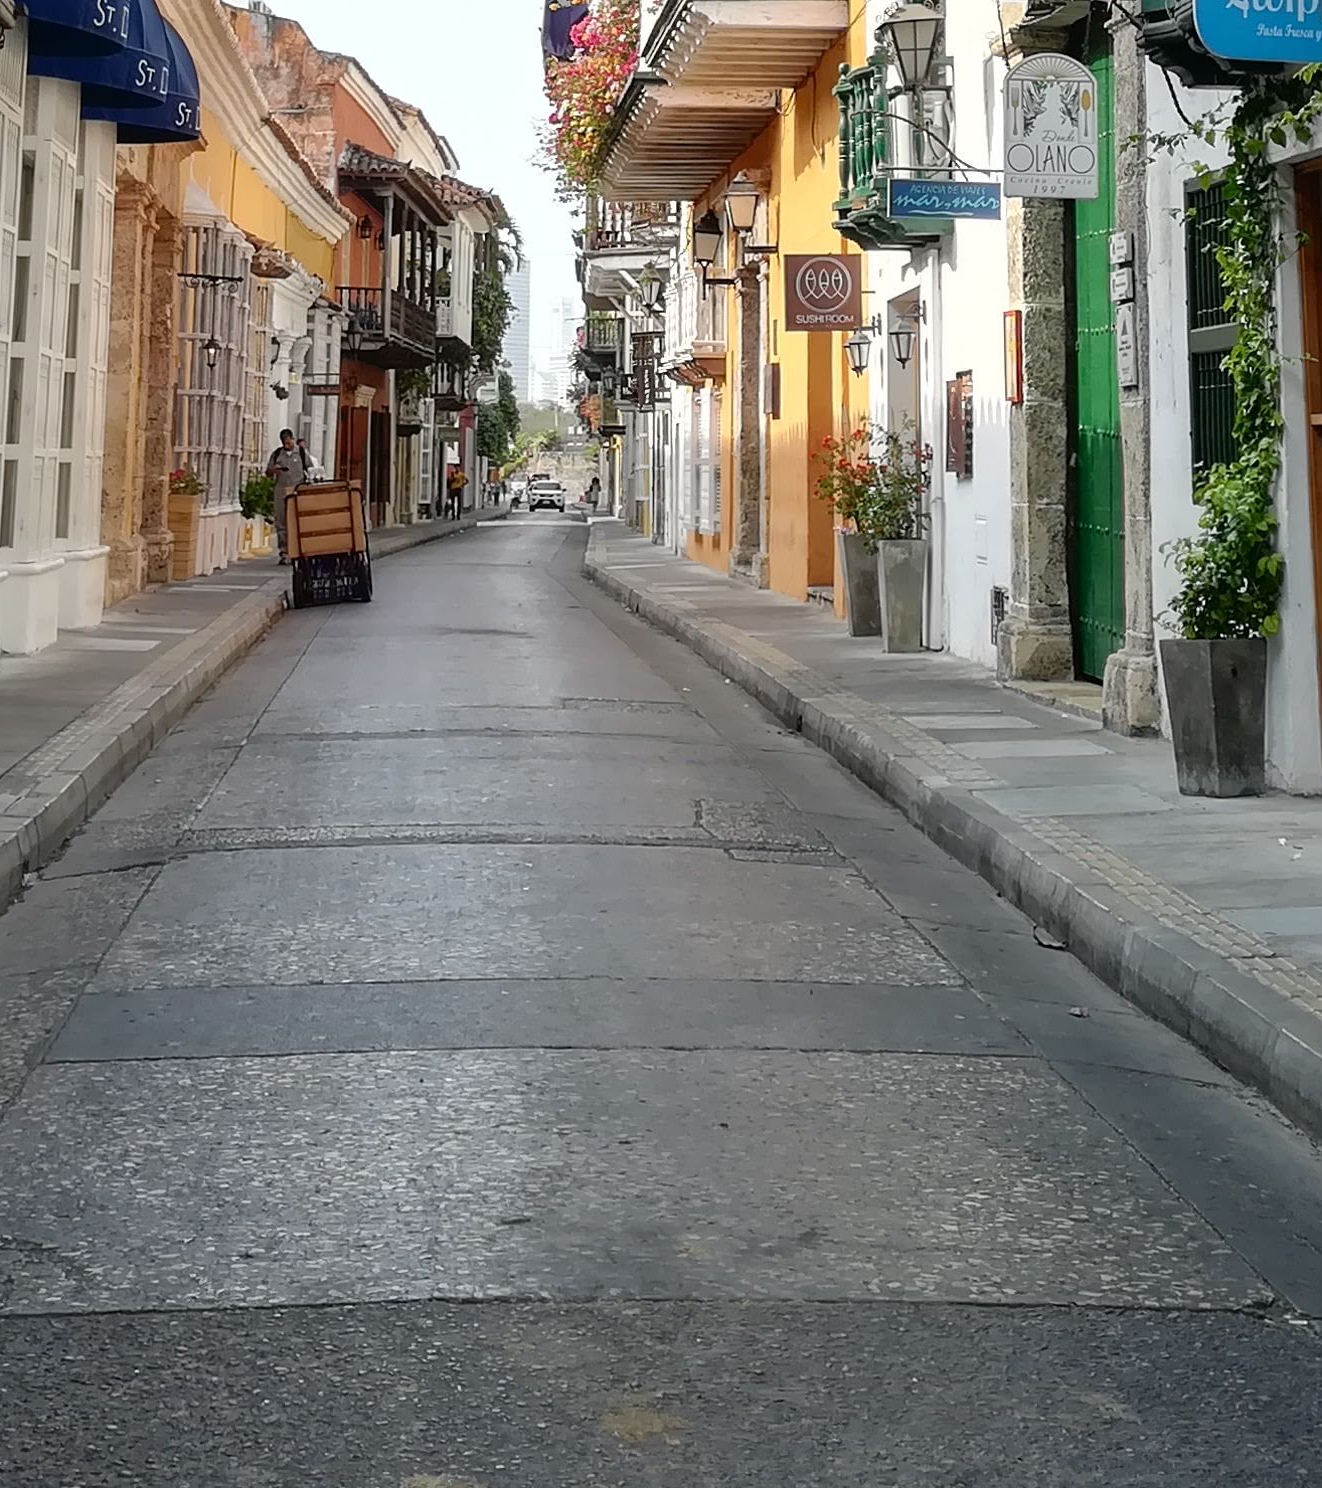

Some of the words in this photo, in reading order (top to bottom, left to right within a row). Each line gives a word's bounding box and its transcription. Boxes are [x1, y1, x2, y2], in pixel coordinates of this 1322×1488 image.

[1256, 23, 1283, 38] Pasta
[1284, 24, 1313, 39] Fresca
[1316, 29, 1322, 42] y
[1007, 143, 1095, 174] OLANO
[910, 184, 946, 194] AGENCIA
[948, 185, 957, 193] DE
[1033, 185, 1066, 194] 1997
[796, 314, 825, 324] SUSHI
[825, 314, 854, 323] ROOM
